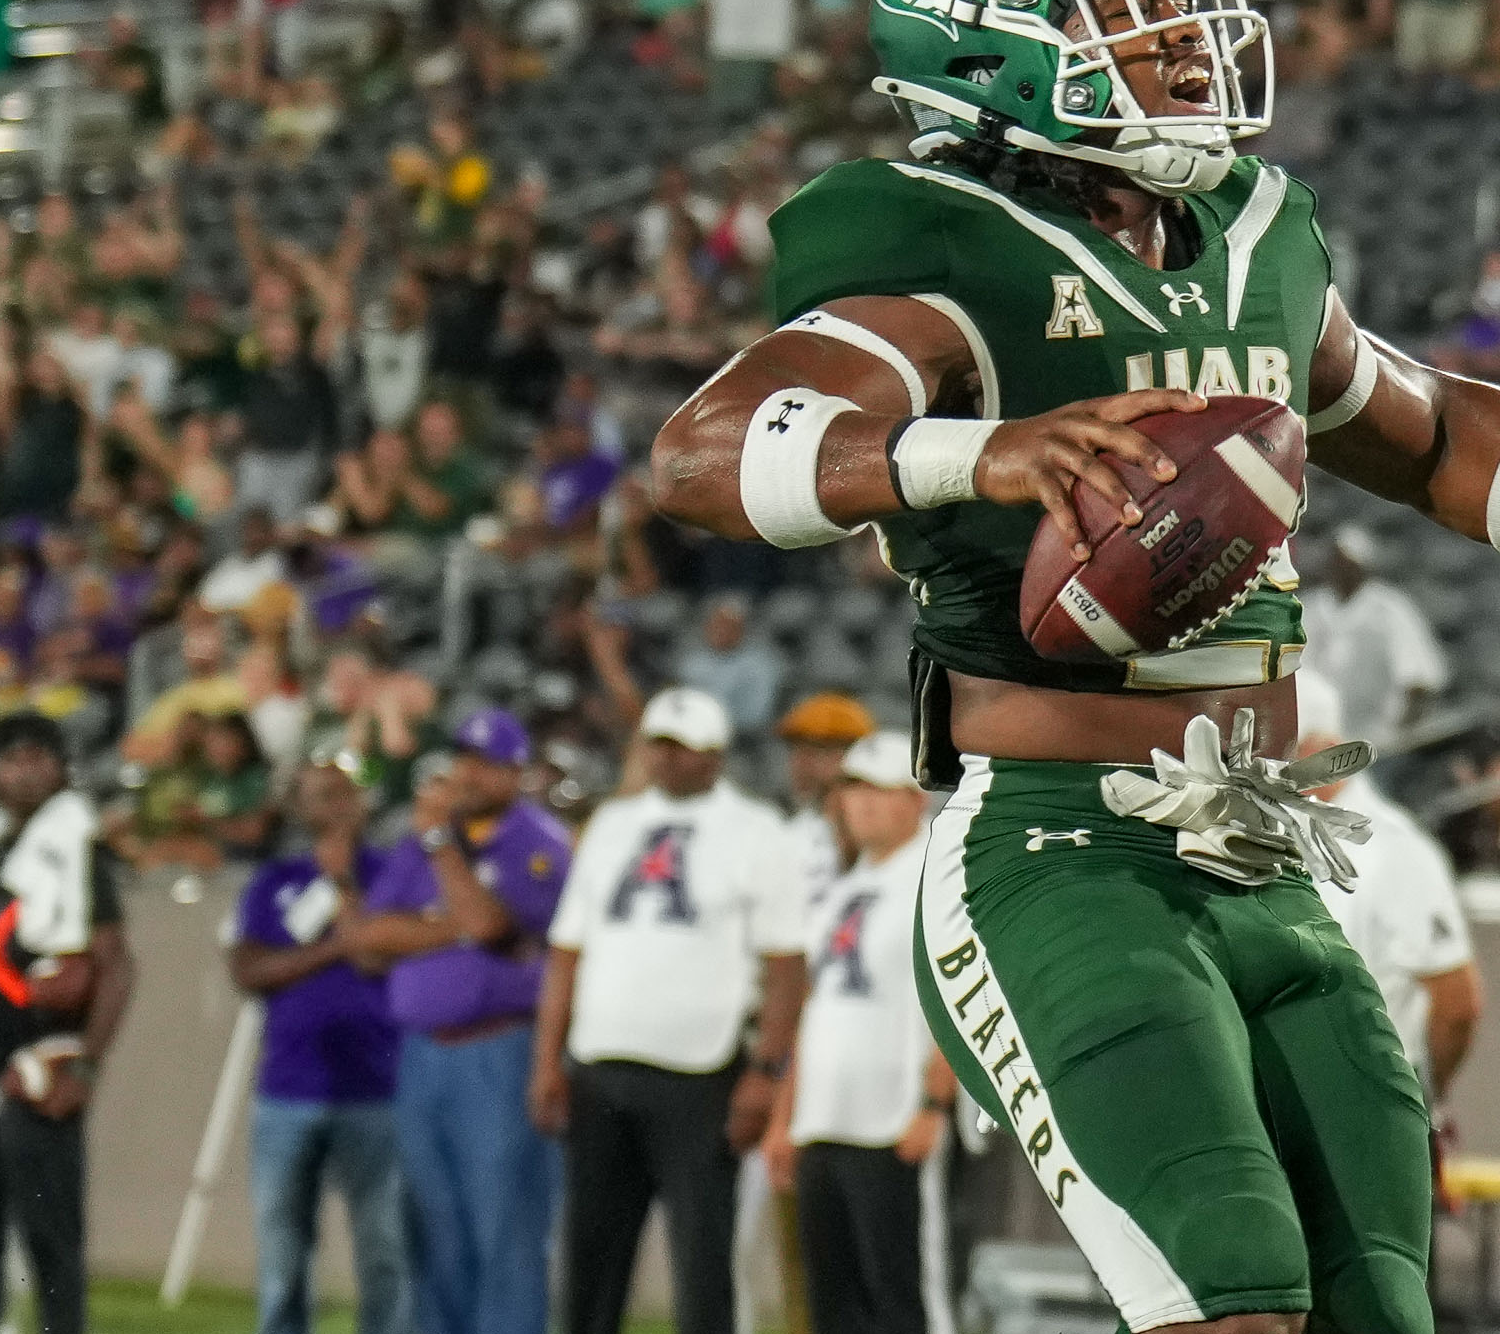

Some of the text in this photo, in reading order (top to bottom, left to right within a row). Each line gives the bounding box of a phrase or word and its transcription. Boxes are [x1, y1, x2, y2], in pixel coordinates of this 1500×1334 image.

[1046, 275, 1105, 339] A
[1126, 346, 1292, 400] UAB
[1139, 508, 1181, 551] NCAA
[1066, 581, 1100, 622] QB24
[1154, 535, 1255, 619] Wilson
[606, 823, 699, 924] A
[936, 937, 1078, 1209] BLAZERS
